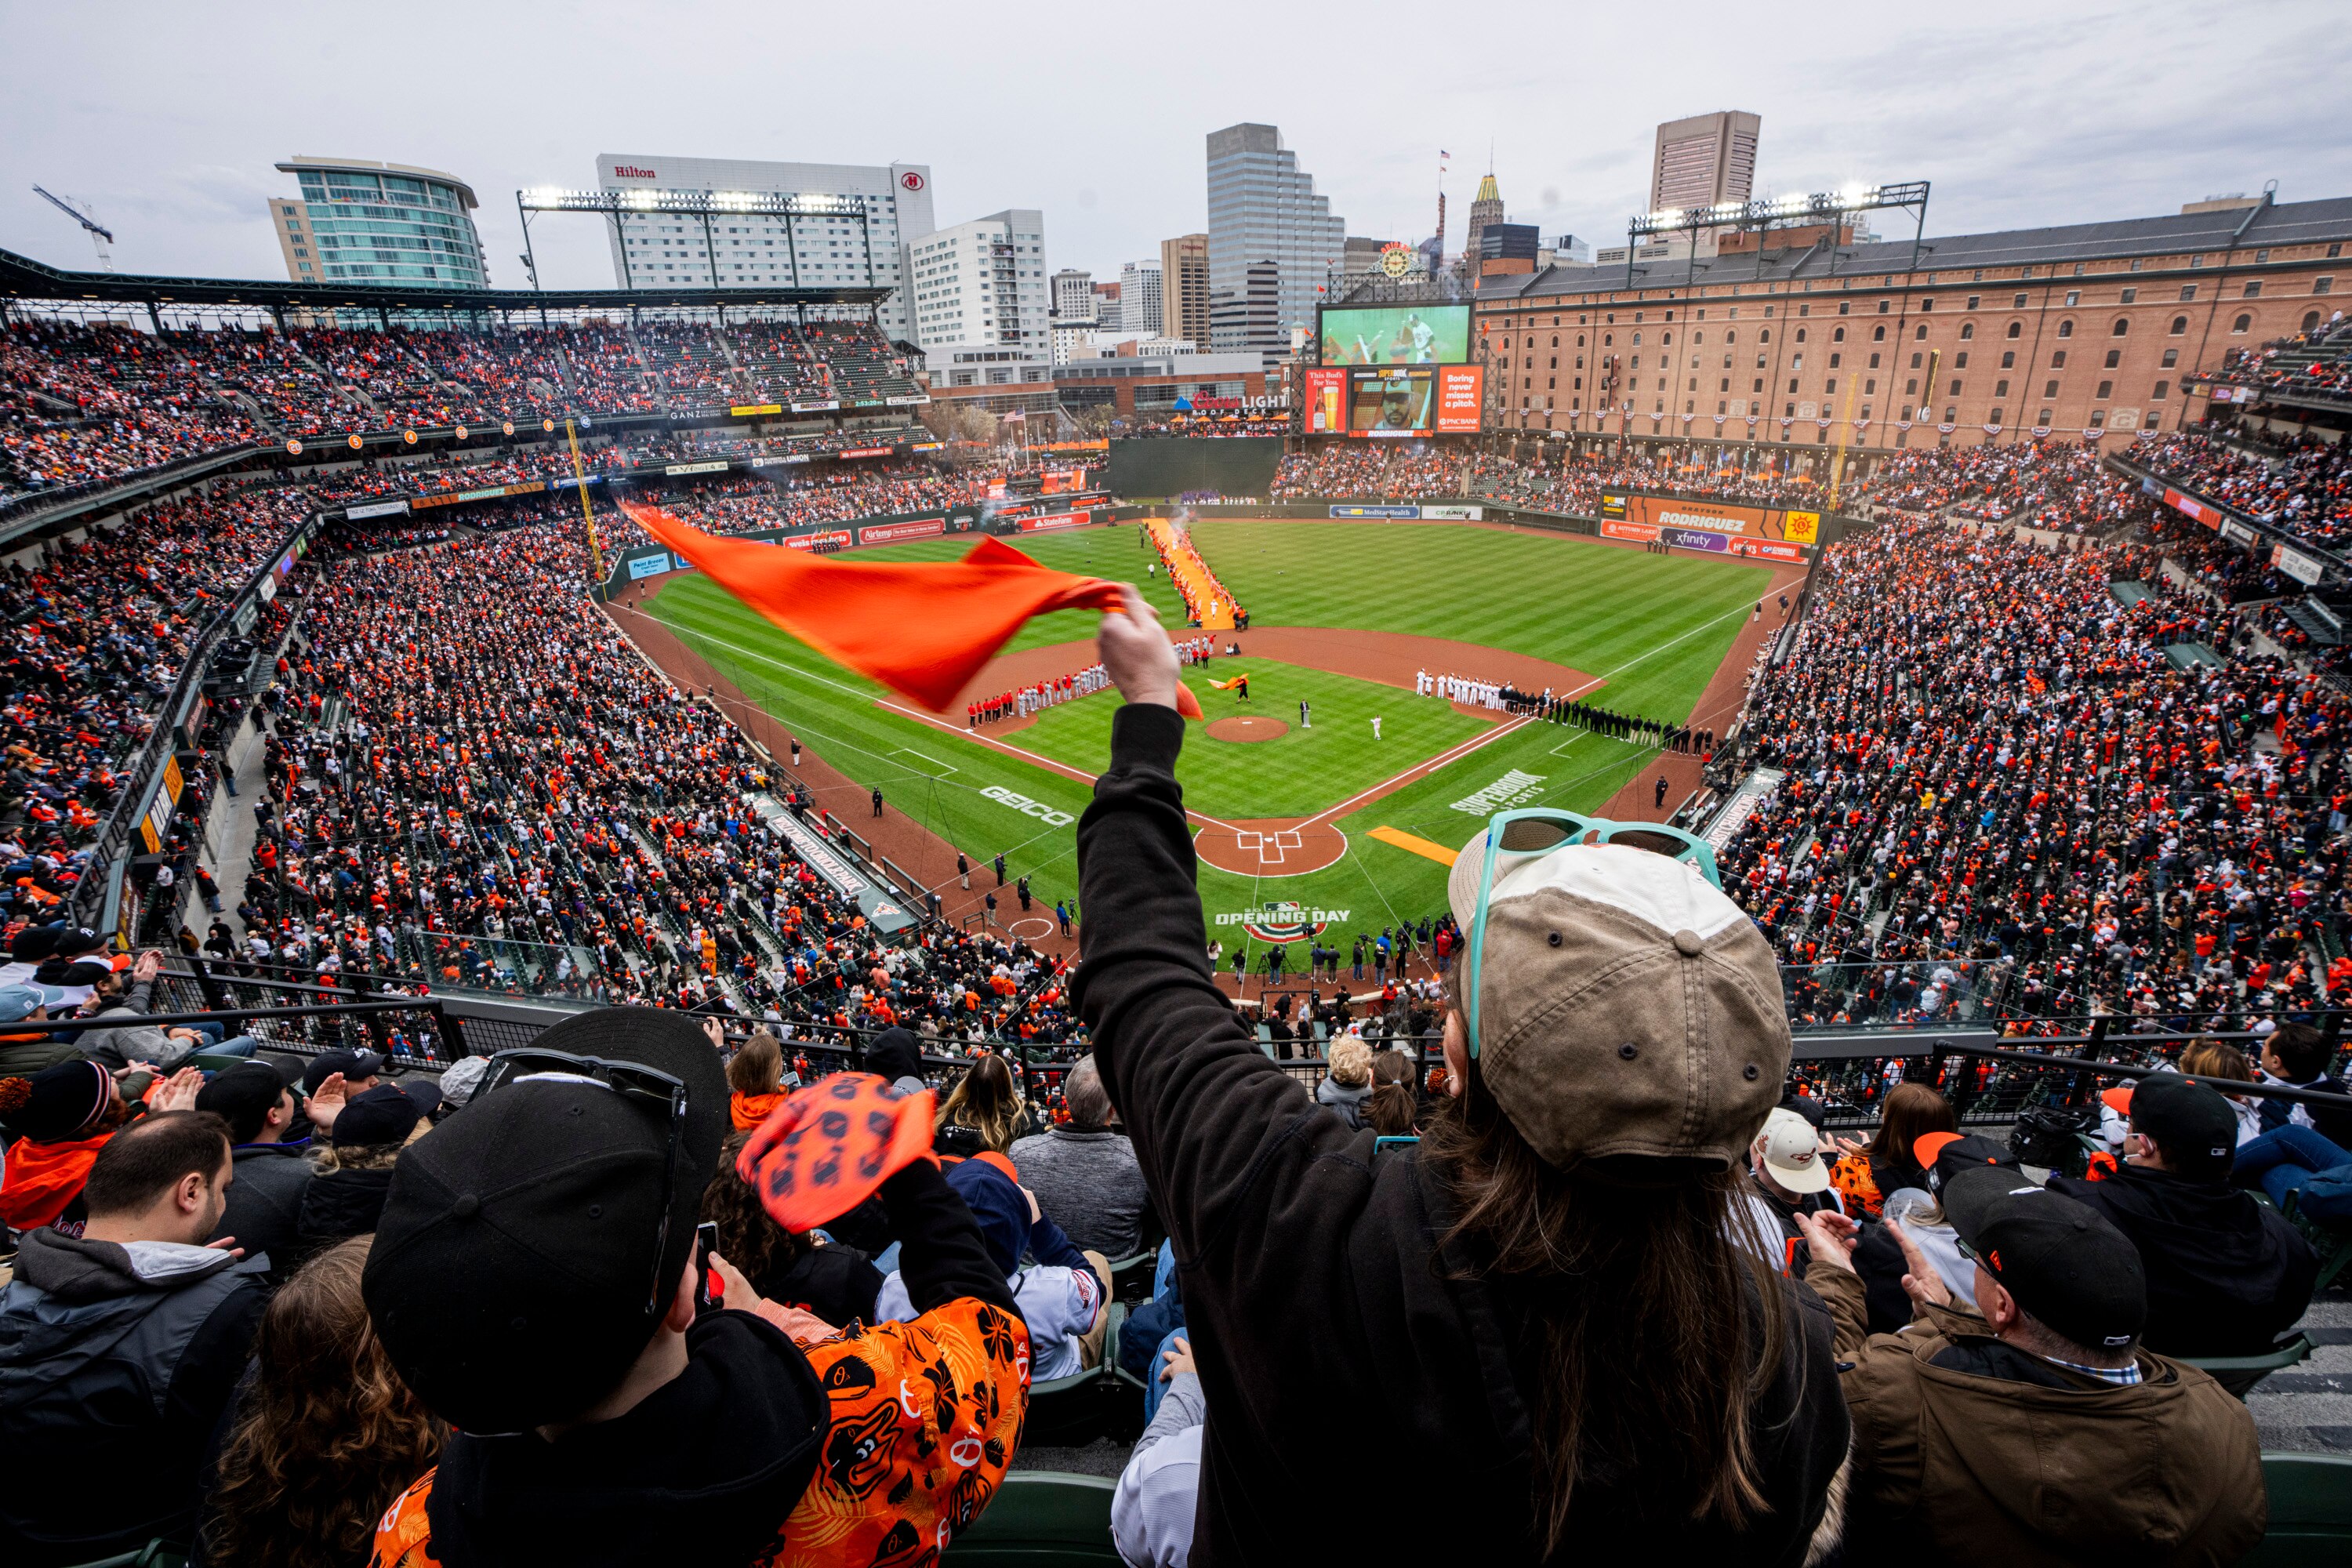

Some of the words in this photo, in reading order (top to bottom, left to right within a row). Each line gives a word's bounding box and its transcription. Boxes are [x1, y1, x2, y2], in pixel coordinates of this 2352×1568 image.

[615, 166, 655, 178] Hilton
[1378, 369, 1407, 378] SUPERBOOK
[1447, 374, 1474, 383] Boring
[1192, 390, 1239, 409] Coors
[1242, 396, 1287, 408] LIGHT
[1452, 399, 1476, 408] pitch.
[670, 410, 701, 420] GANZ
[787, 454, 809, 463] UNION
[458, 488, 505, 501] RODRIGUEZ
[989, 489, 1004, 497] 30
[1682, 506, 1724, 515] GRAYSON
[1659, 511, 1746, 532] RODRIGUEZ
[865, 529, 892, 540] Airtemp
[1676, 532, 1711, 548] xfinity
[789, 539, 809, 549] weis
[1449, 768, 1548, 816] SUPERBOOK
[1500, 786, 1544, 811] SPORTS
[158, 782, 172, 819] BAY
[979, 786, 1075, 826] GEICO
[151, 799, 167, 837] OLD
[773, 816, 808, 846] WELCOME
[810, 849, 843, 875] ORIOLE
[834, 869, 864, 891] PARK
[1215, 911, 1307, 925] OPENING
[1312, 910, 1351, 922] DAY
